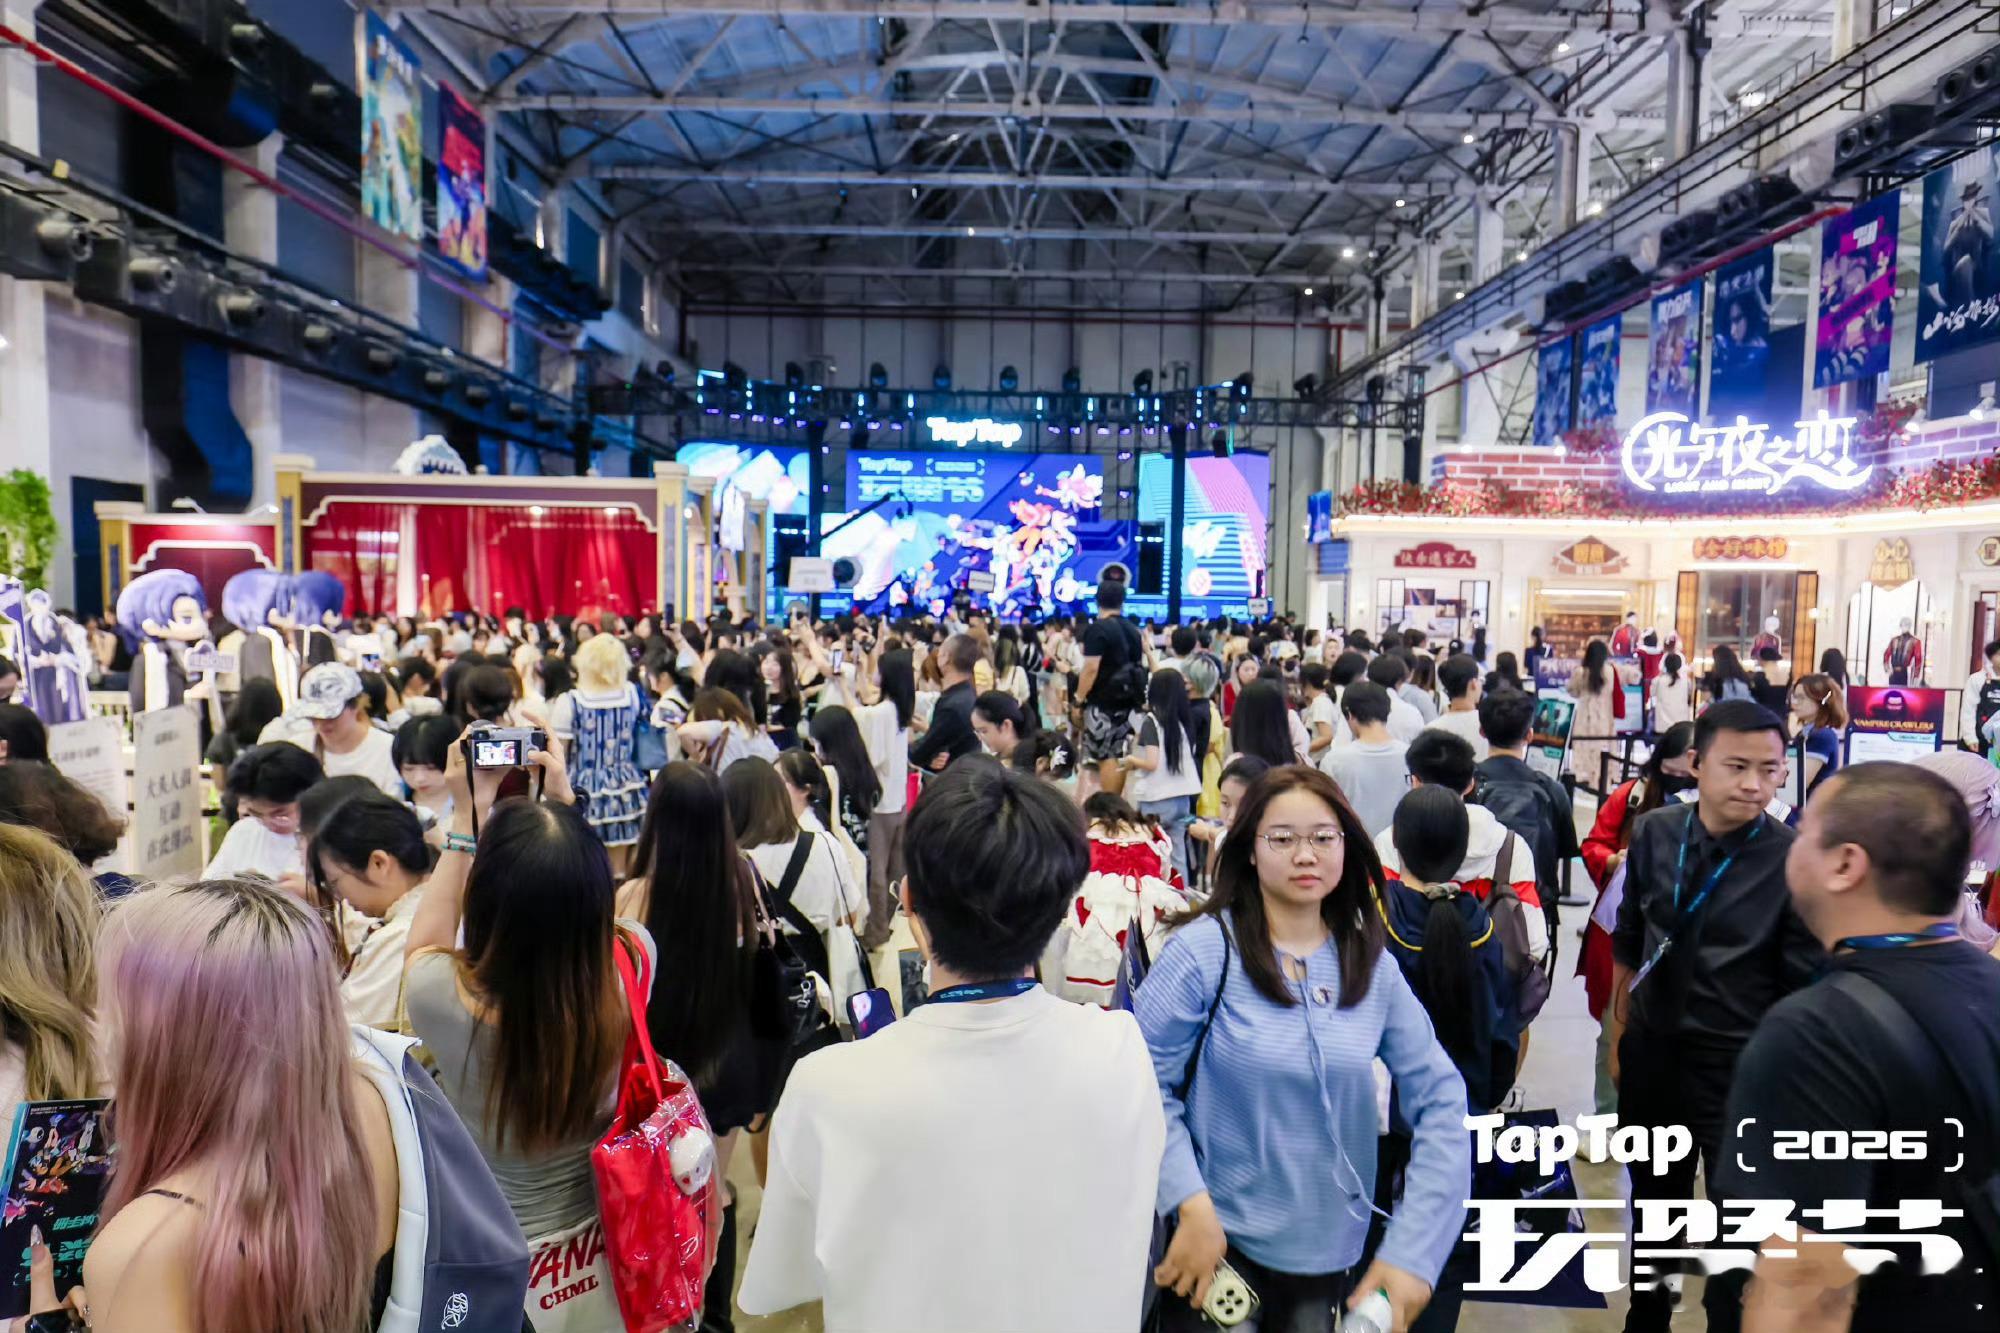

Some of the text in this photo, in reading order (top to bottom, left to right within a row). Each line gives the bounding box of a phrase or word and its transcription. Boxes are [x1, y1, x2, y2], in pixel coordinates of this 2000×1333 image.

[927, 417, 1023, 447] TapTap
[1621, 409, 1873, 495] 光与夜之恋
[539, 1275, 599, 1310] CHML
